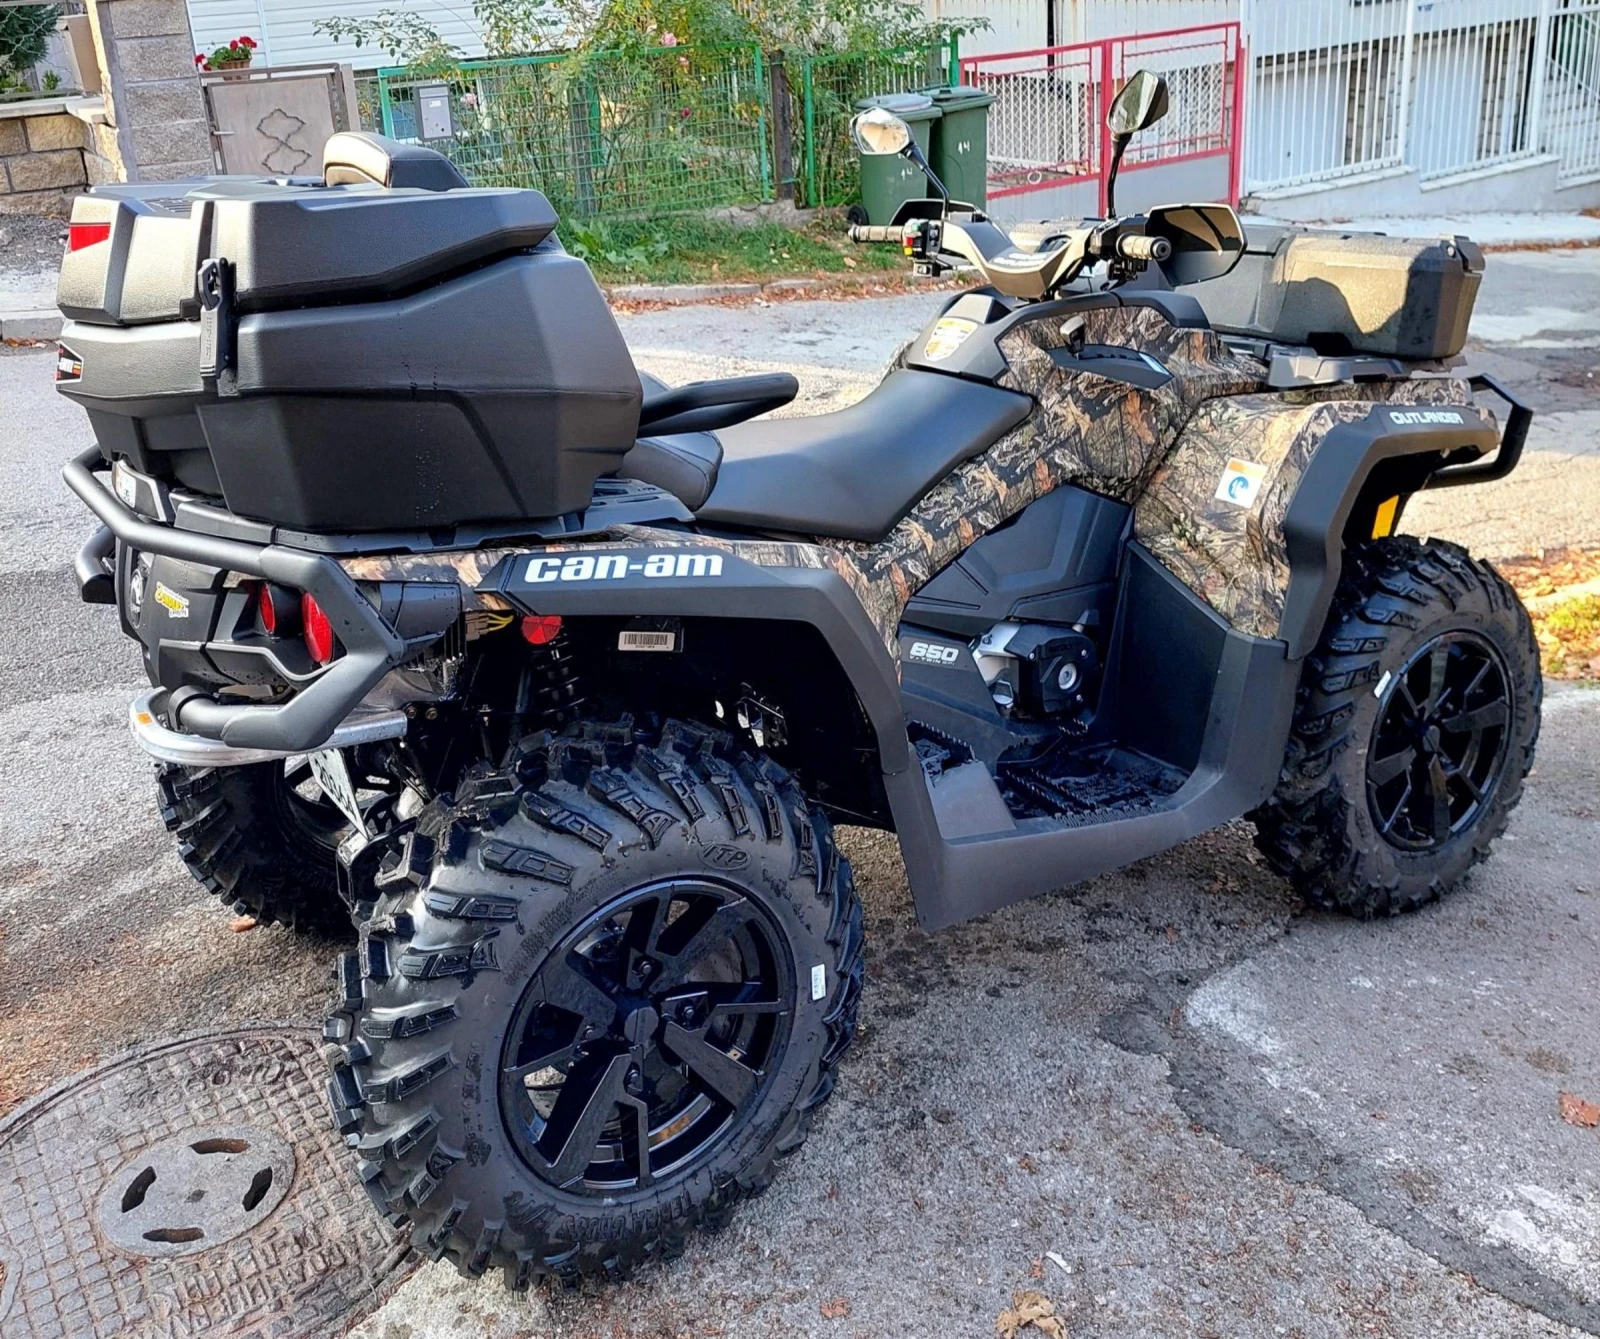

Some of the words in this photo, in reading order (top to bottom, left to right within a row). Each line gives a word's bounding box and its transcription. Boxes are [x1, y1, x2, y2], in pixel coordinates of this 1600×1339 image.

[1389, 411, 1464, 425] OUTLANDER
[524, 554, 723, 583] can-am
[909, 642, 959, 662] 650
[702, 845, 749, 866] ITP
